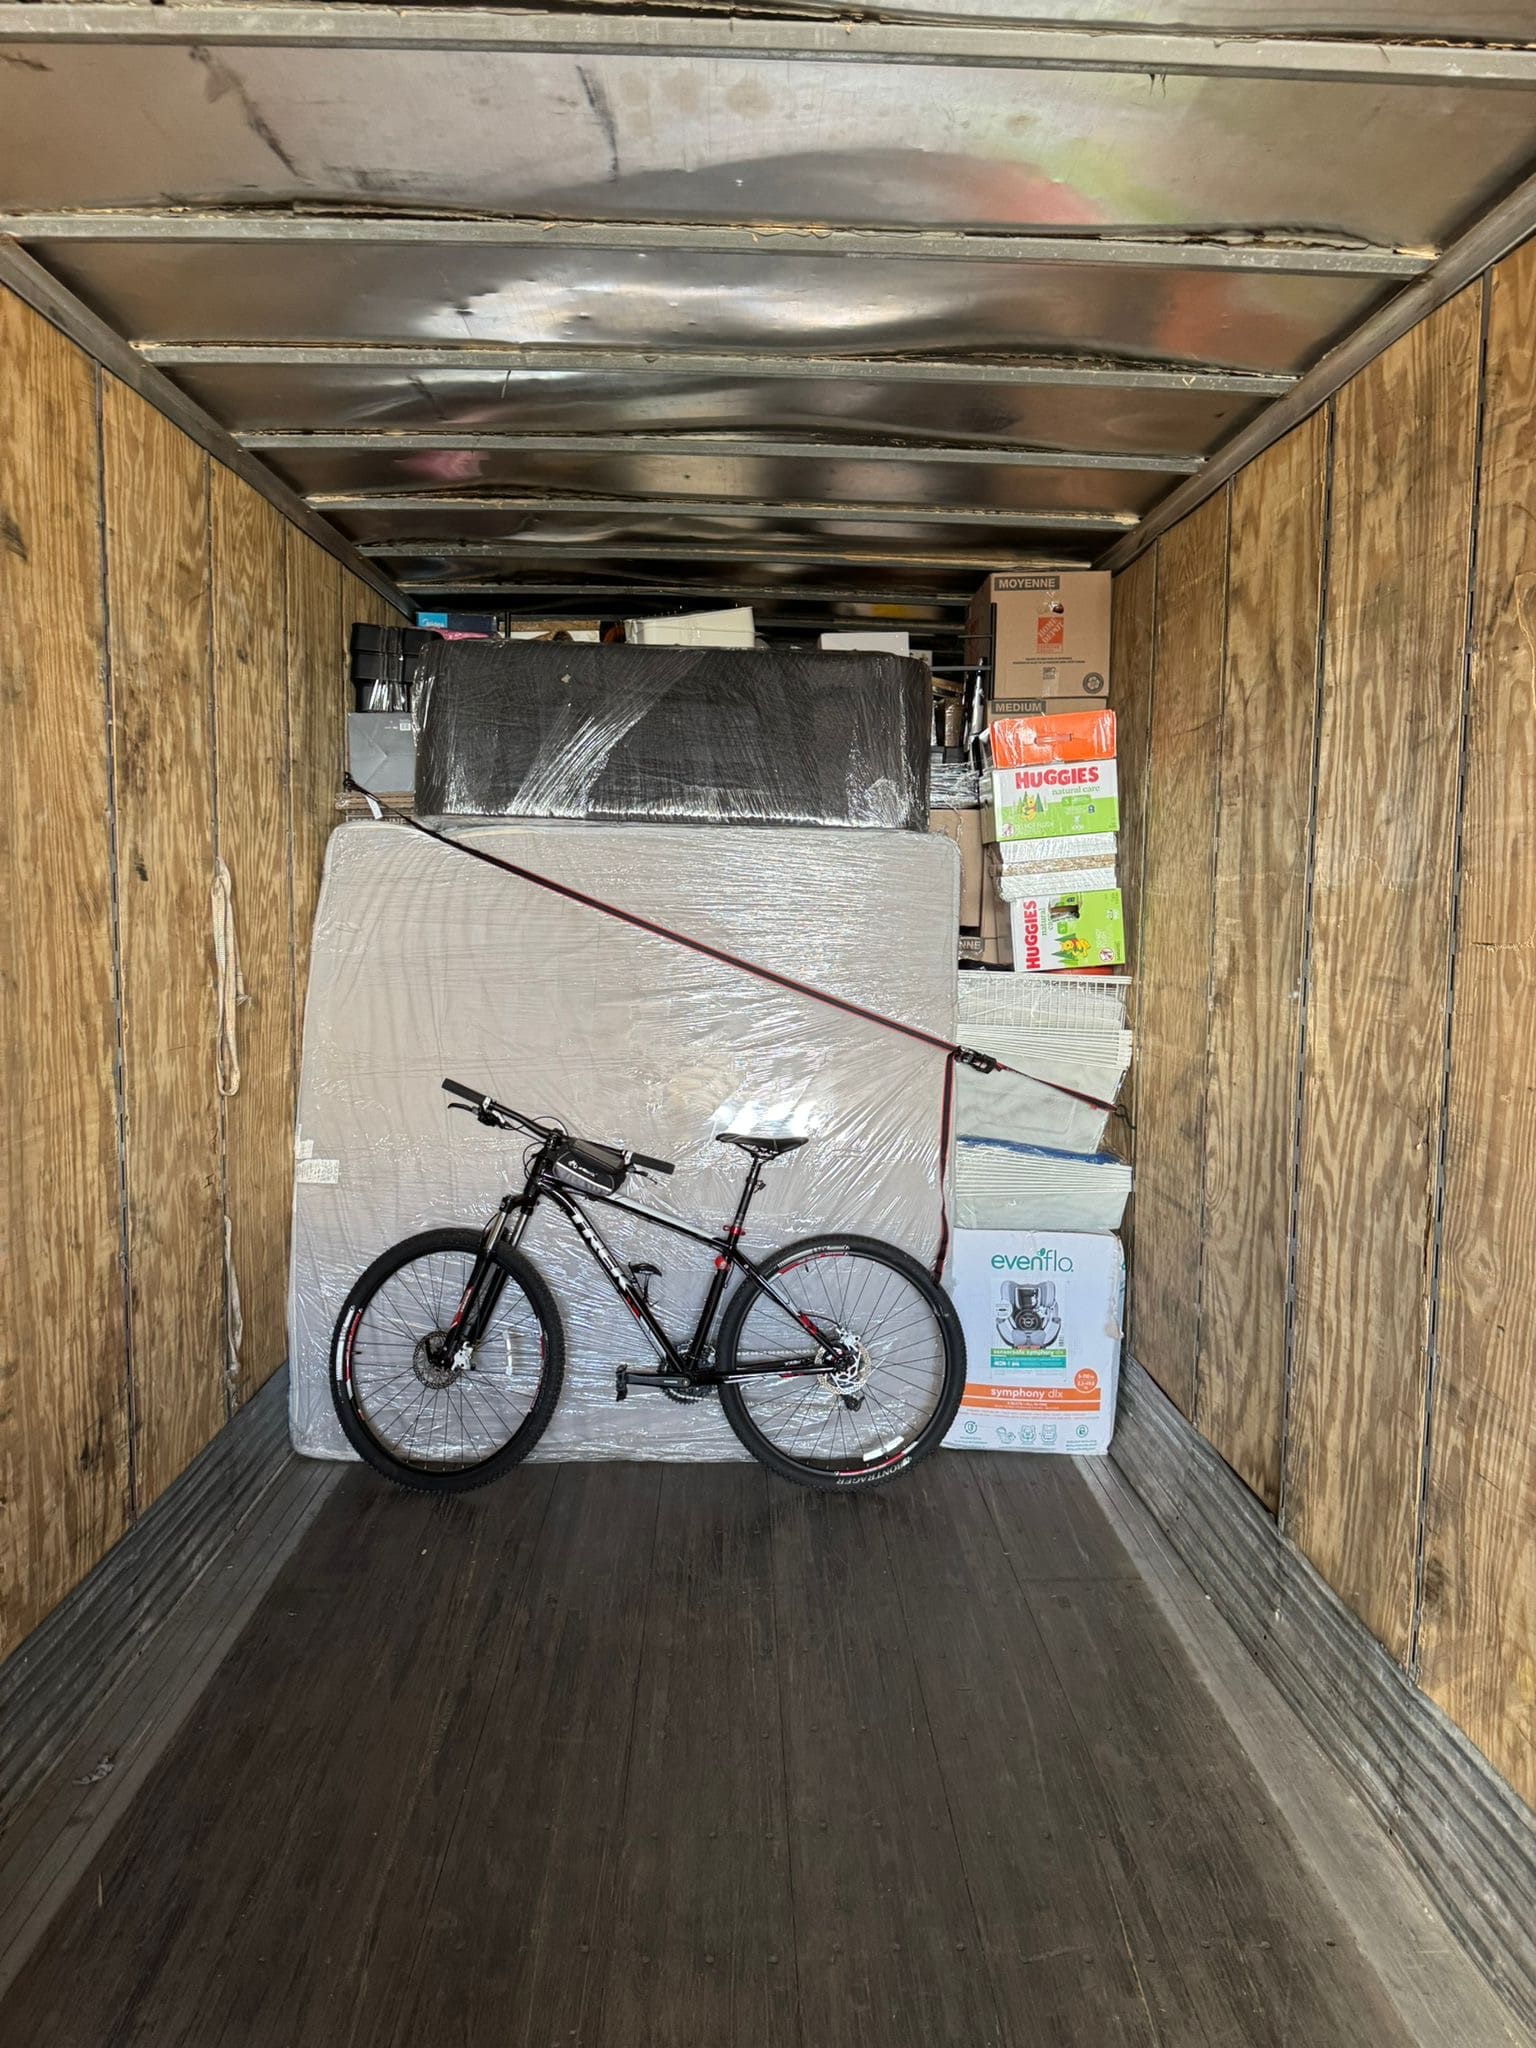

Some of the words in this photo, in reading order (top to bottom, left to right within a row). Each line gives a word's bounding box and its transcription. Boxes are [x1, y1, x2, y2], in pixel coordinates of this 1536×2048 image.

[999, 578, 1056, 589] MOYENNE
[995, 702, 1042, 713] MEDIUM
[1015, 766, 1099, 789] HUGGIES
[1052, 786, 1081, 796] natural
[1083, 785, 1101, 793] care
[1023, 900, 1040, 970] HUGGIES
[572, 1207, 633, 1290] TREK
[991, 1387, 1045, 1399] symphony
[1047, 1389, 1064, 1398] dlx
